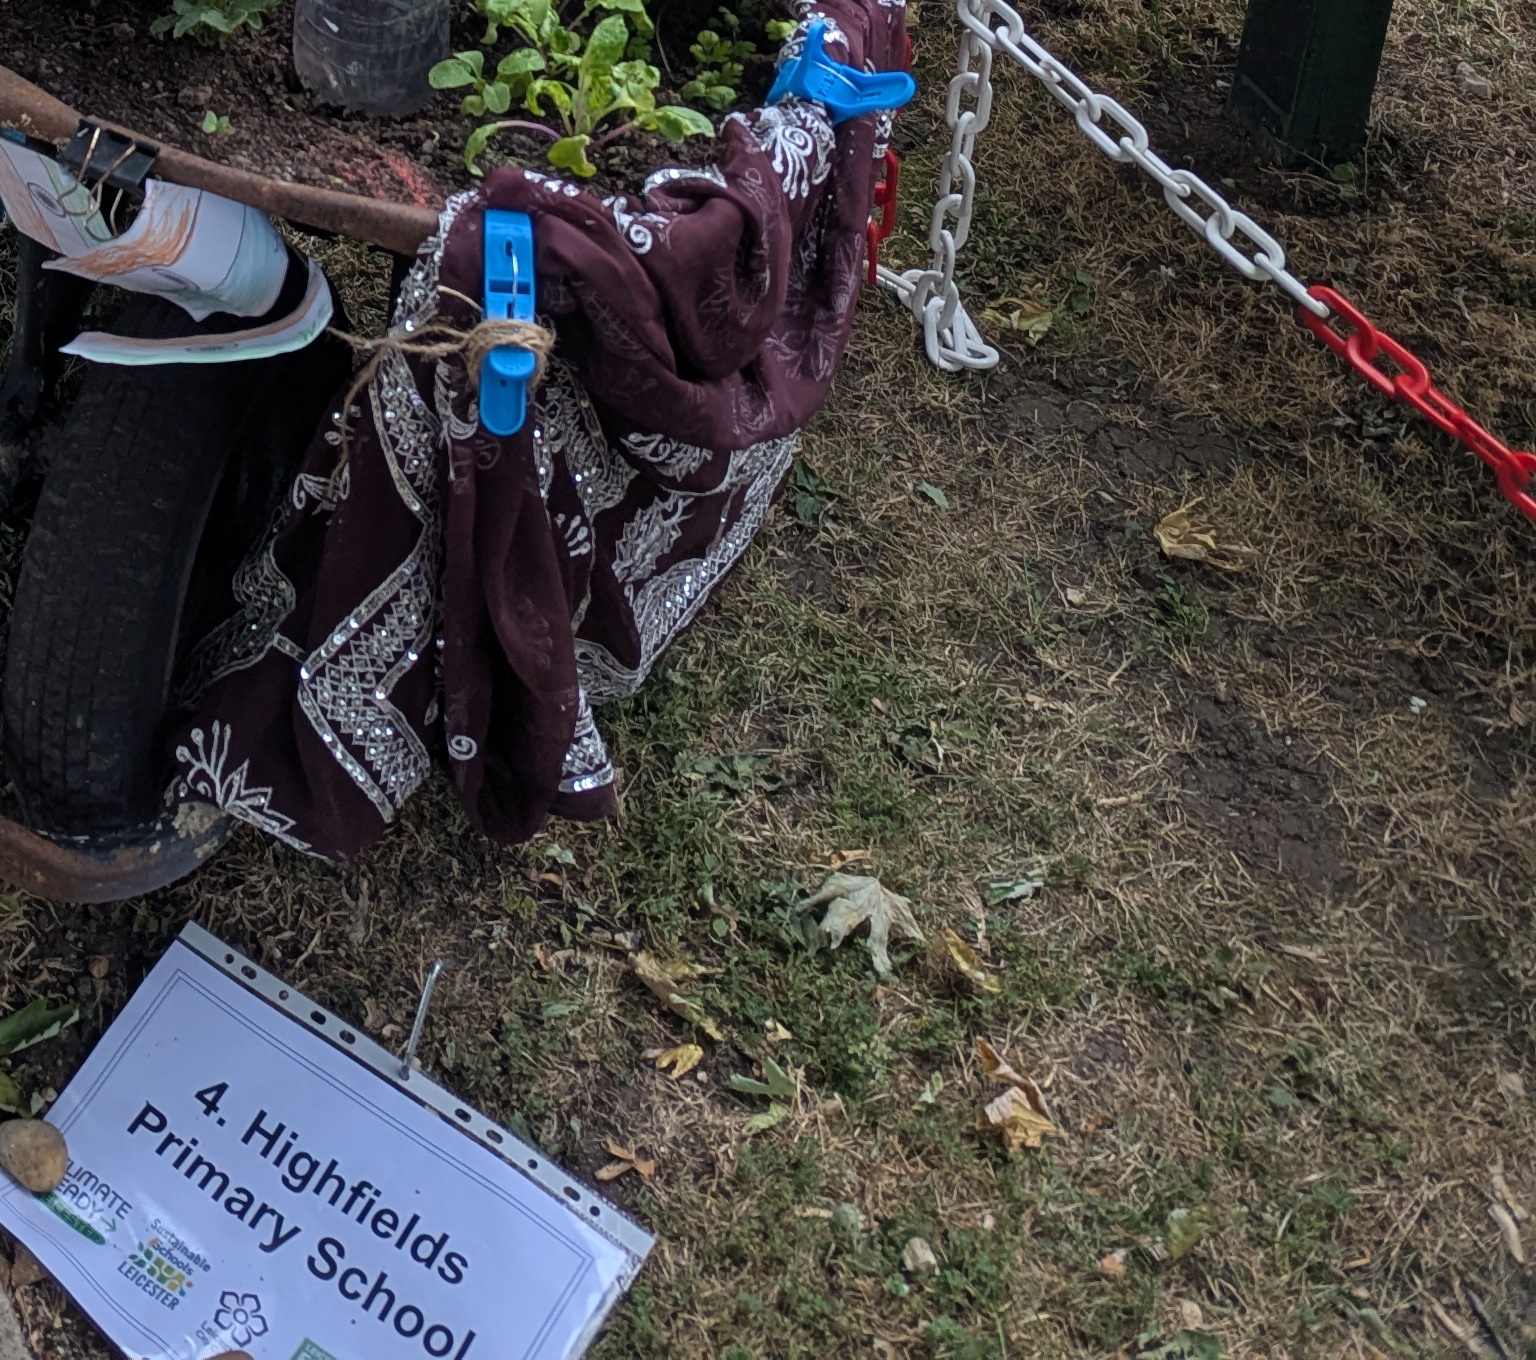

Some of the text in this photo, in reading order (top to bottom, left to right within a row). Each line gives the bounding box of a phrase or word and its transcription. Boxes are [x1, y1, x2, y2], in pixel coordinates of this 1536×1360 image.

[56, 1178, 105, 1220] EADY
[194, 1081, 470, 1285] 4. Highfields
[127, 1100, 477, 1360] Primary School
[150, 1218, 212, 1273] Sustainable
[151, 1238, 195, 1277] Schools
[117, 1260, 181, 1312] LEICESTER
